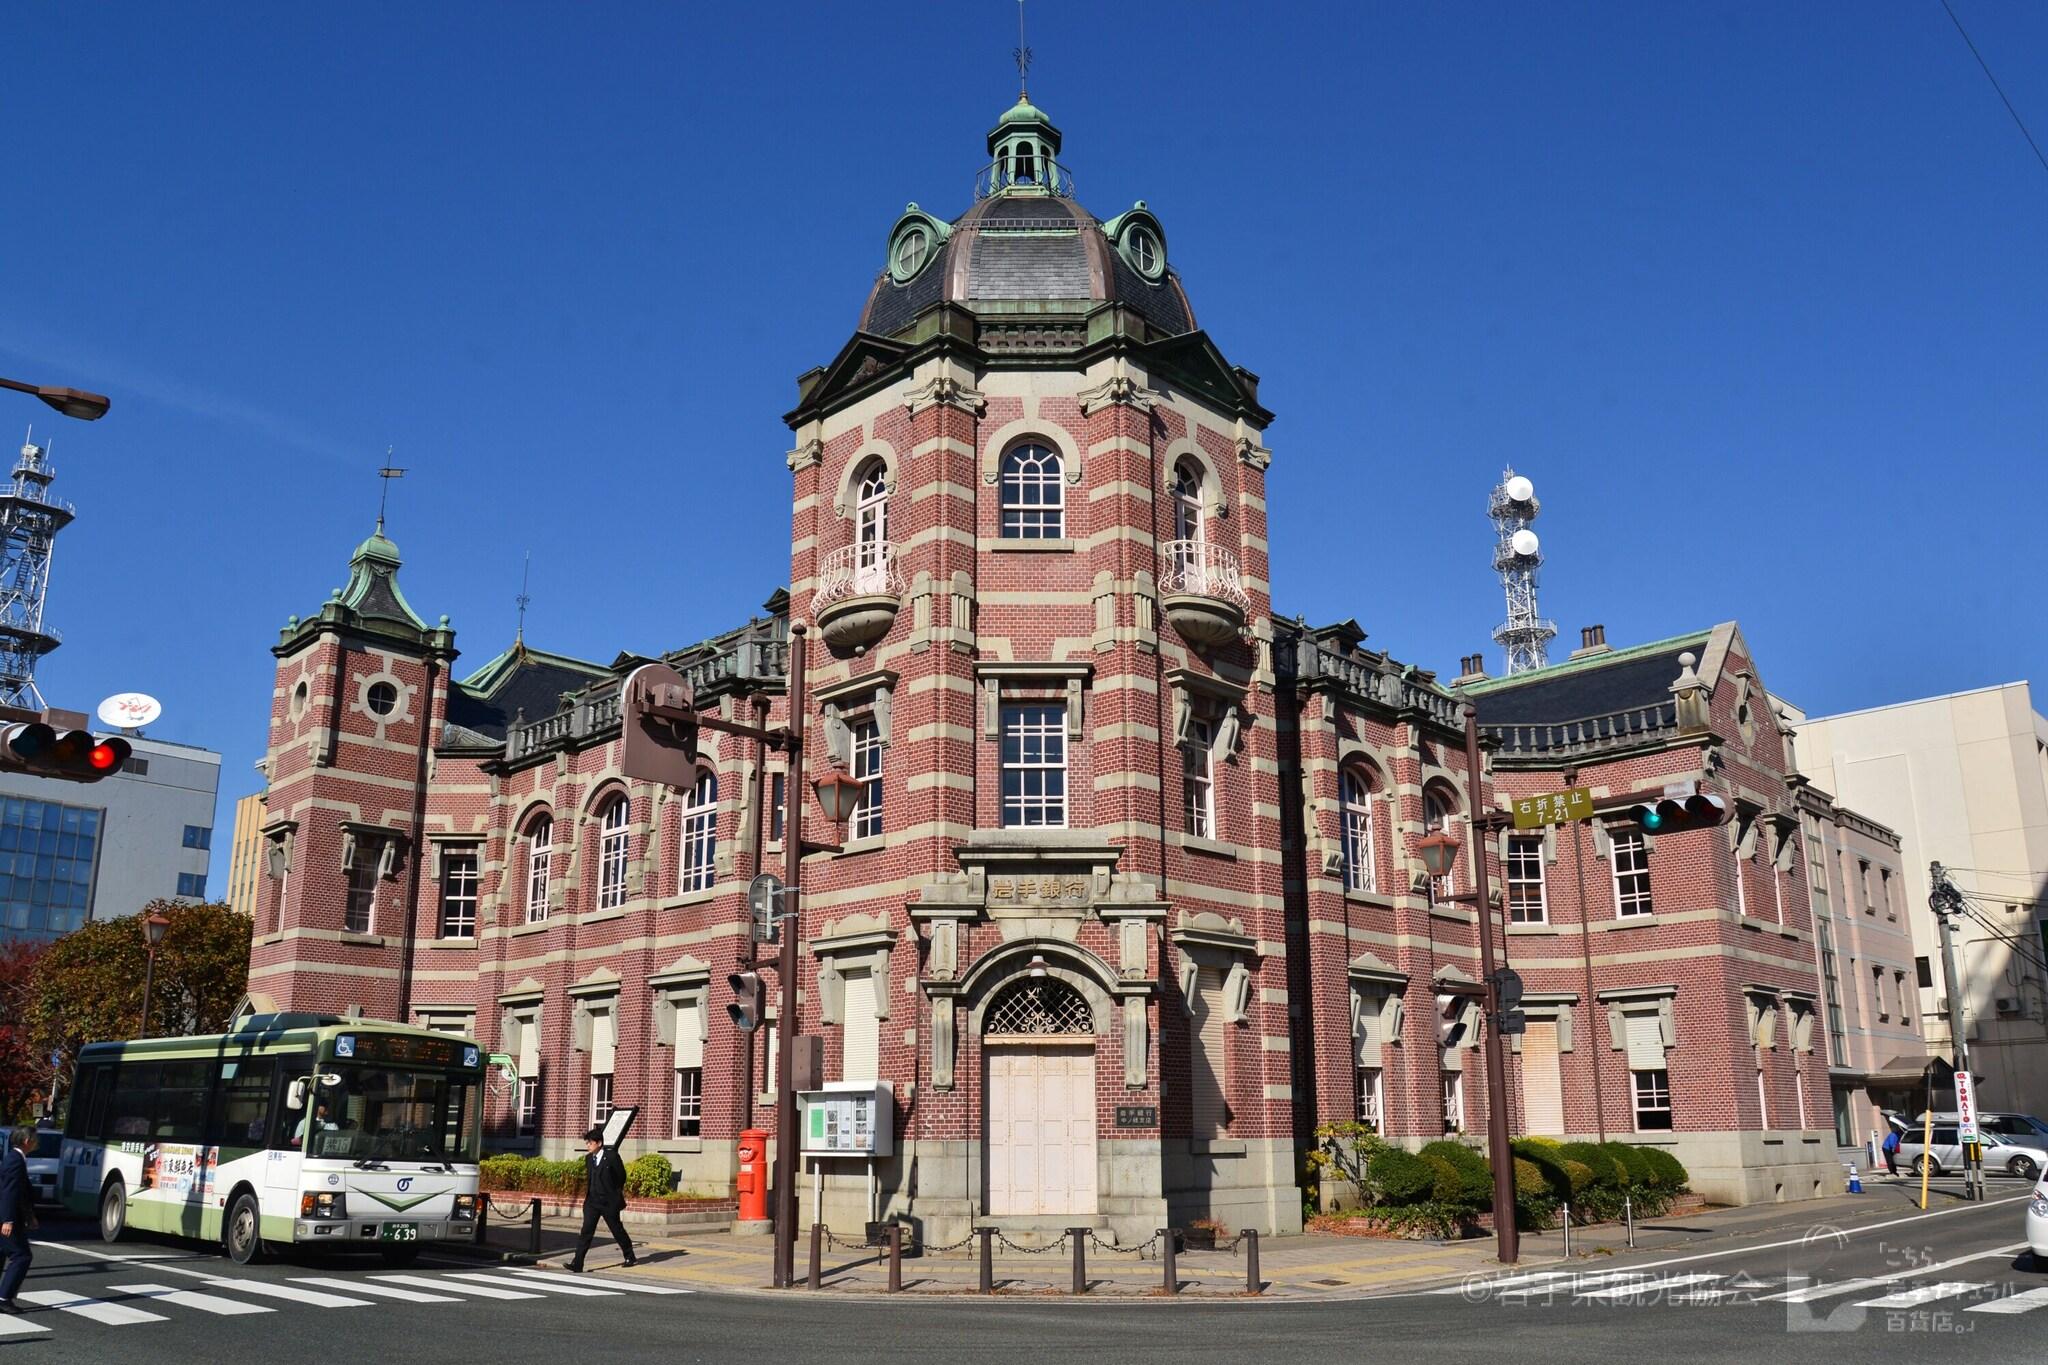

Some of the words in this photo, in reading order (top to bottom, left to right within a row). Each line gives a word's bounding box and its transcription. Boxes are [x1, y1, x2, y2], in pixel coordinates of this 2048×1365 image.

[1519, 792, 1583, 814] 右折禁止
[1536, 808, 1569, 824] 7-21
[992, 880, 1086, 899] 岩手銀行
[1959, 1081, 1970, 1123] TOMATO
[394, 1228, 417, 1241] 639
